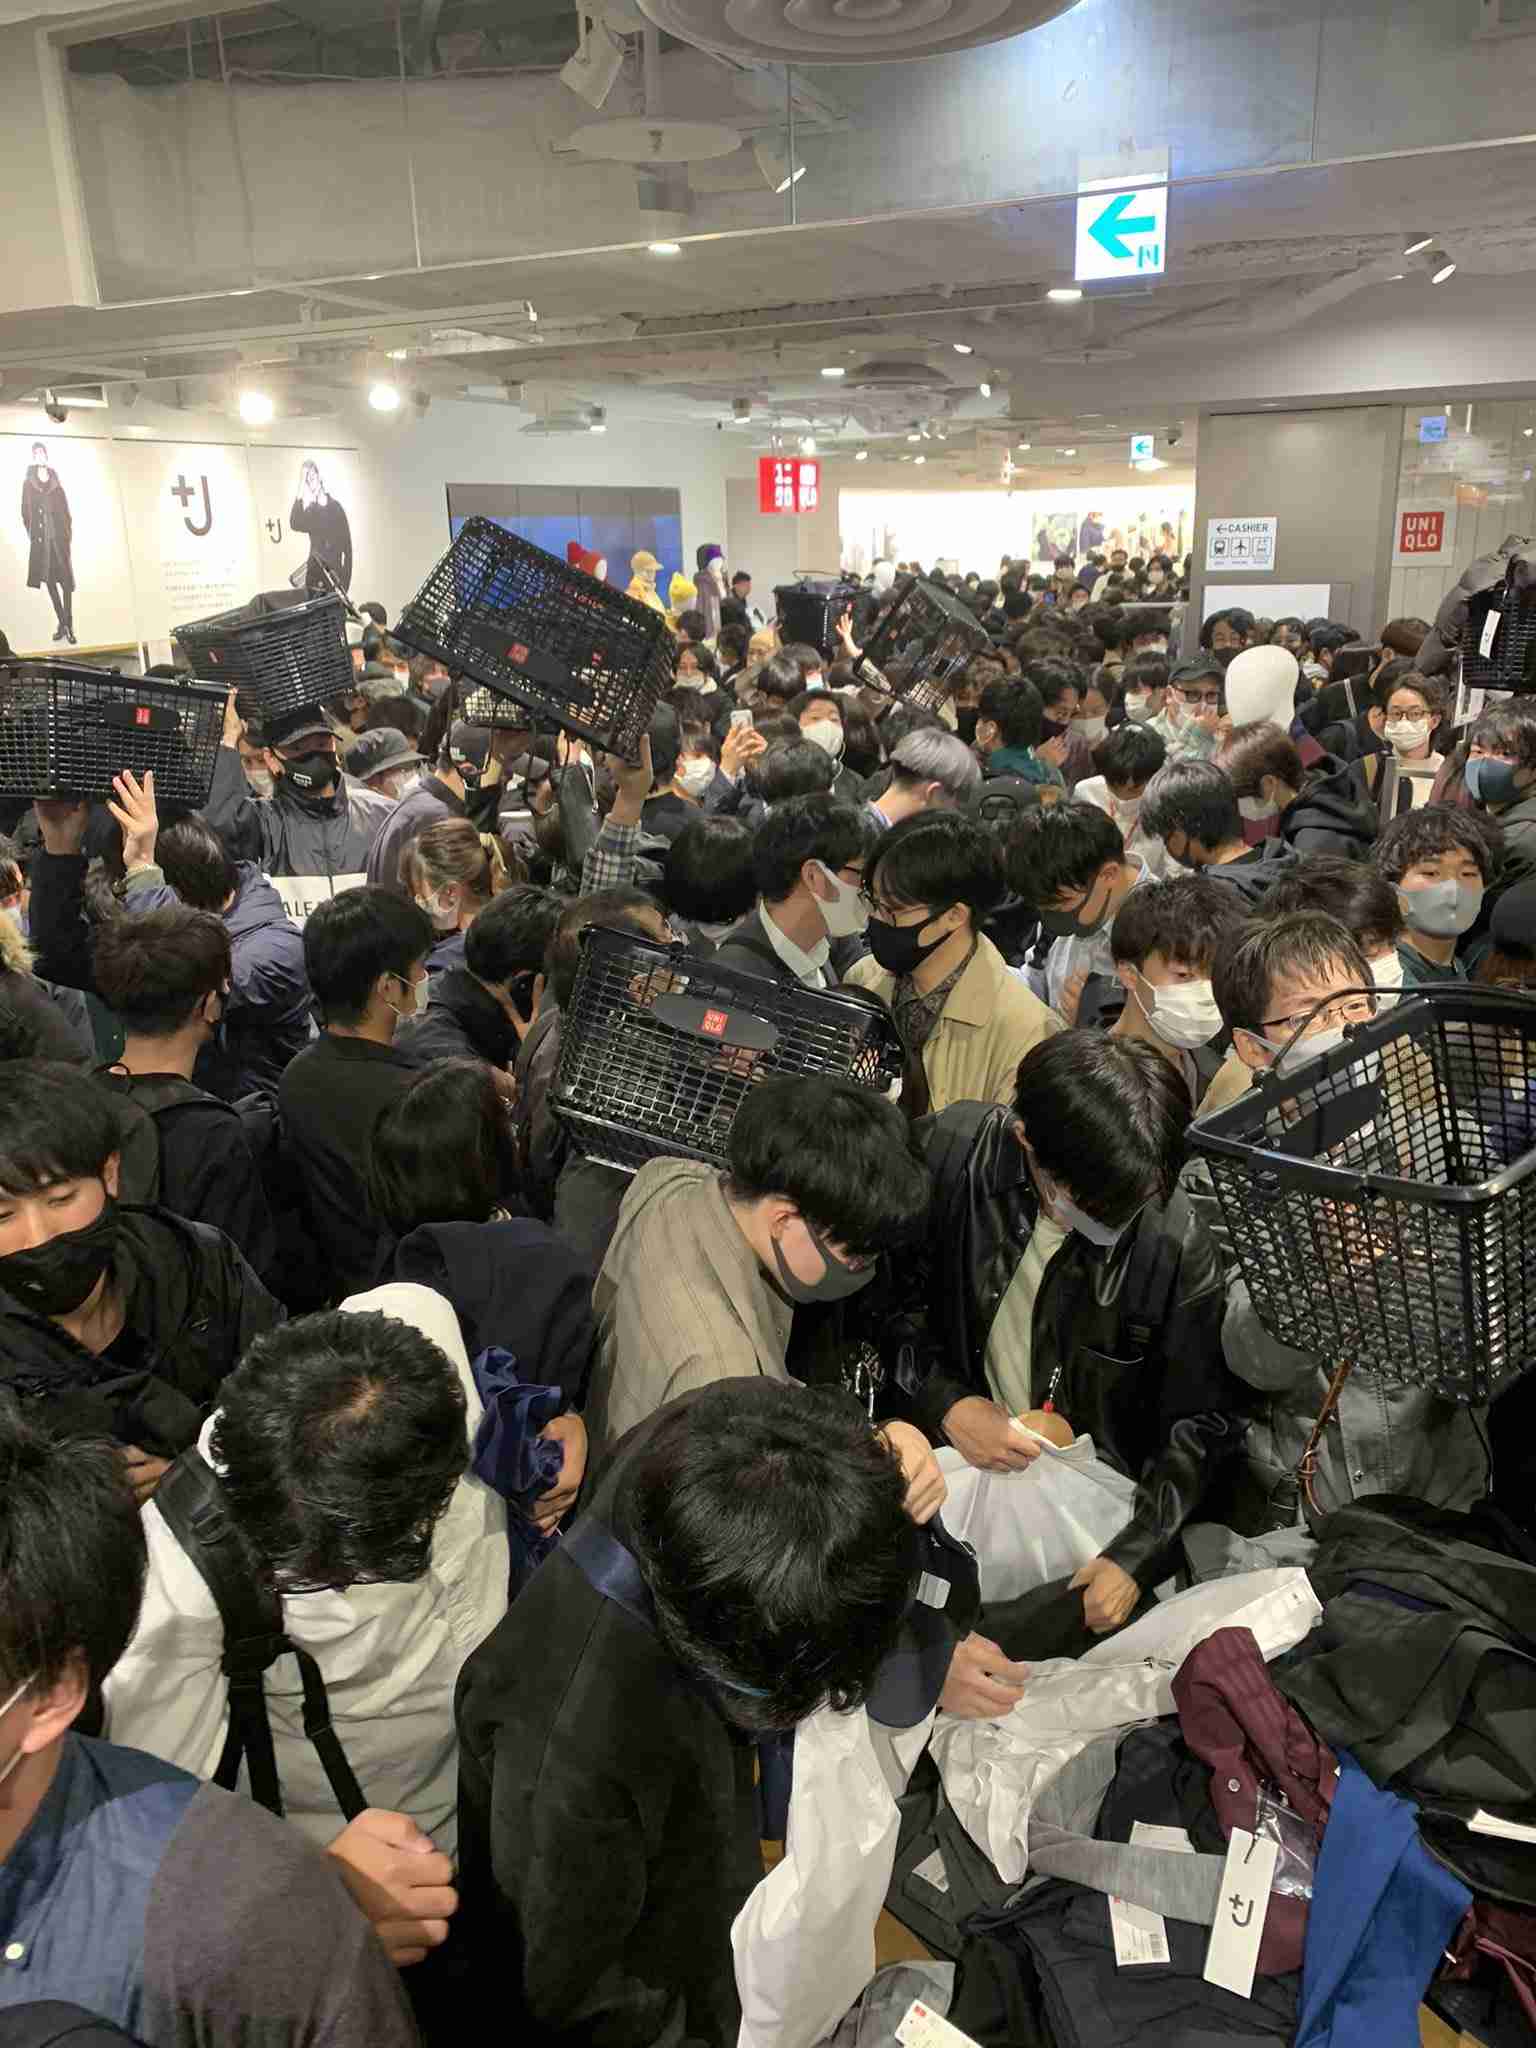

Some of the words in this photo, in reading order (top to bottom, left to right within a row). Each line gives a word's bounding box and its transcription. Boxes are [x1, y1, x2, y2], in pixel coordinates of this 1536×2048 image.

[1228, 522, 1269, 533] CASHIER
[1406, 516, 1437, 531] UNI
[1405, 533, 1438, 551] QLO
